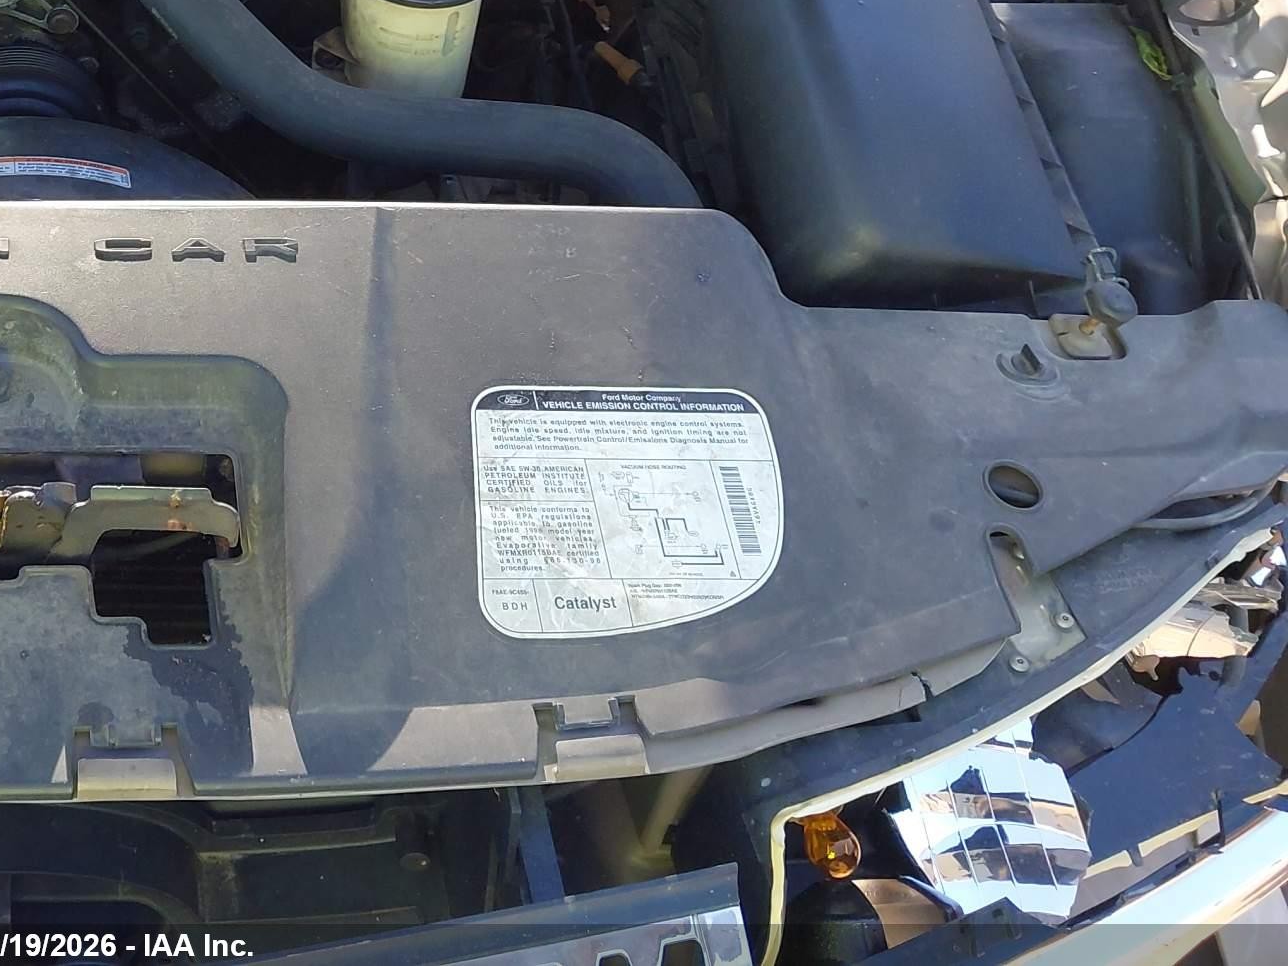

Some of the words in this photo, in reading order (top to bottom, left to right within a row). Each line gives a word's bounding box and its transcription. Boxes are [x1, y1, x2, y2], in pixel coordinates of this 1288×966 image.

[93, 236, 299, 263] CAR
[645, 394, 681, 403] Company
[542, 401, 584, 409] VEHICLE
[585, 401, 631, 410] EMISSION
[632, 402, 679, 411] CONTROL
[681, 403, 745, 412] INFORMATION
[489, 417, 506, 425] This
[550, 419, 587, 427] equipped
[651, 420, 677, 428] engine
[491, 426, 520, 434] Engine
[686, 429, 713, 437] timing
[670, 437, 707, 445] Diagnosis
[494, 442, 533, 450] additional
[544, 465, 584, 473] AMERICAN
[542, 472, 585, 480] INSTITUTE
[496, 542, 556, 550] Evaporative
[567, 542, 598, 550] family
[499, 557, 529, 565] using
[554, 595, 617, 612] Catalyst
